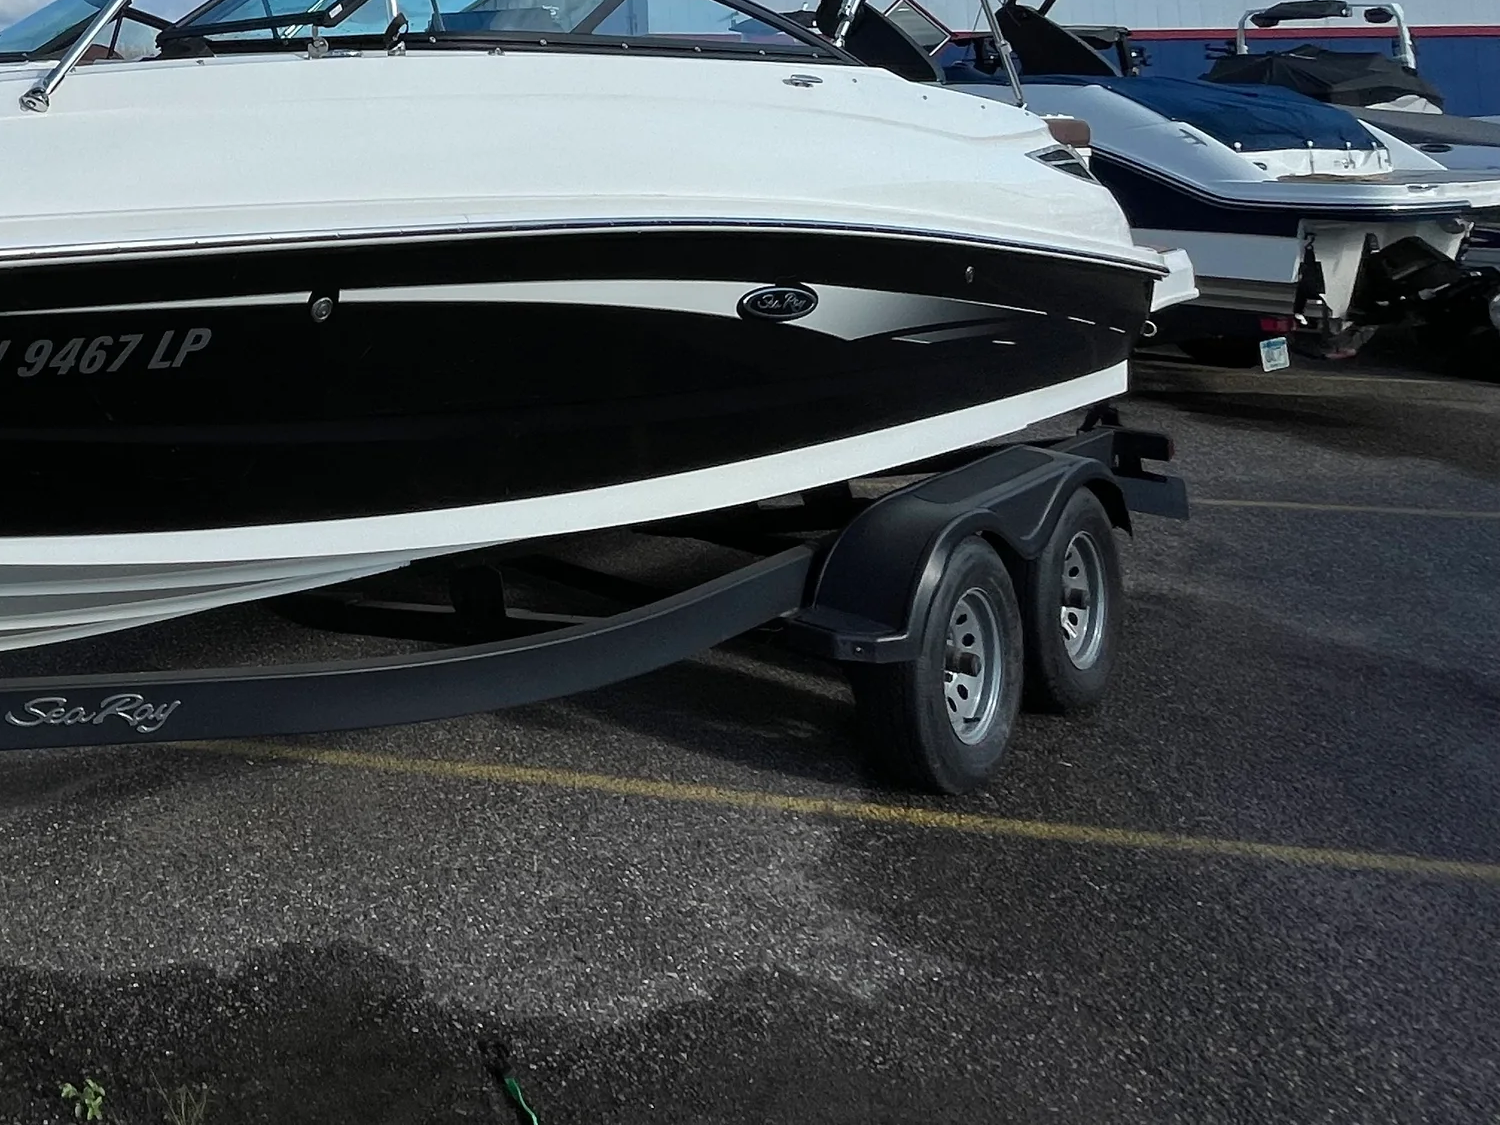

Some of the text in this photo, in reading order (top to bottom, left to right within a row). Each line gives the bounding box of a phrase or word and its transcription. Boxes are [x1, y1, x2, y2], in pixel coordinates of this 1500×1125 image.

[17, 333, 144, 377] 9467
[148, 328, 213, 370] LP
[5, 693, 182, 734] Sea Ray
